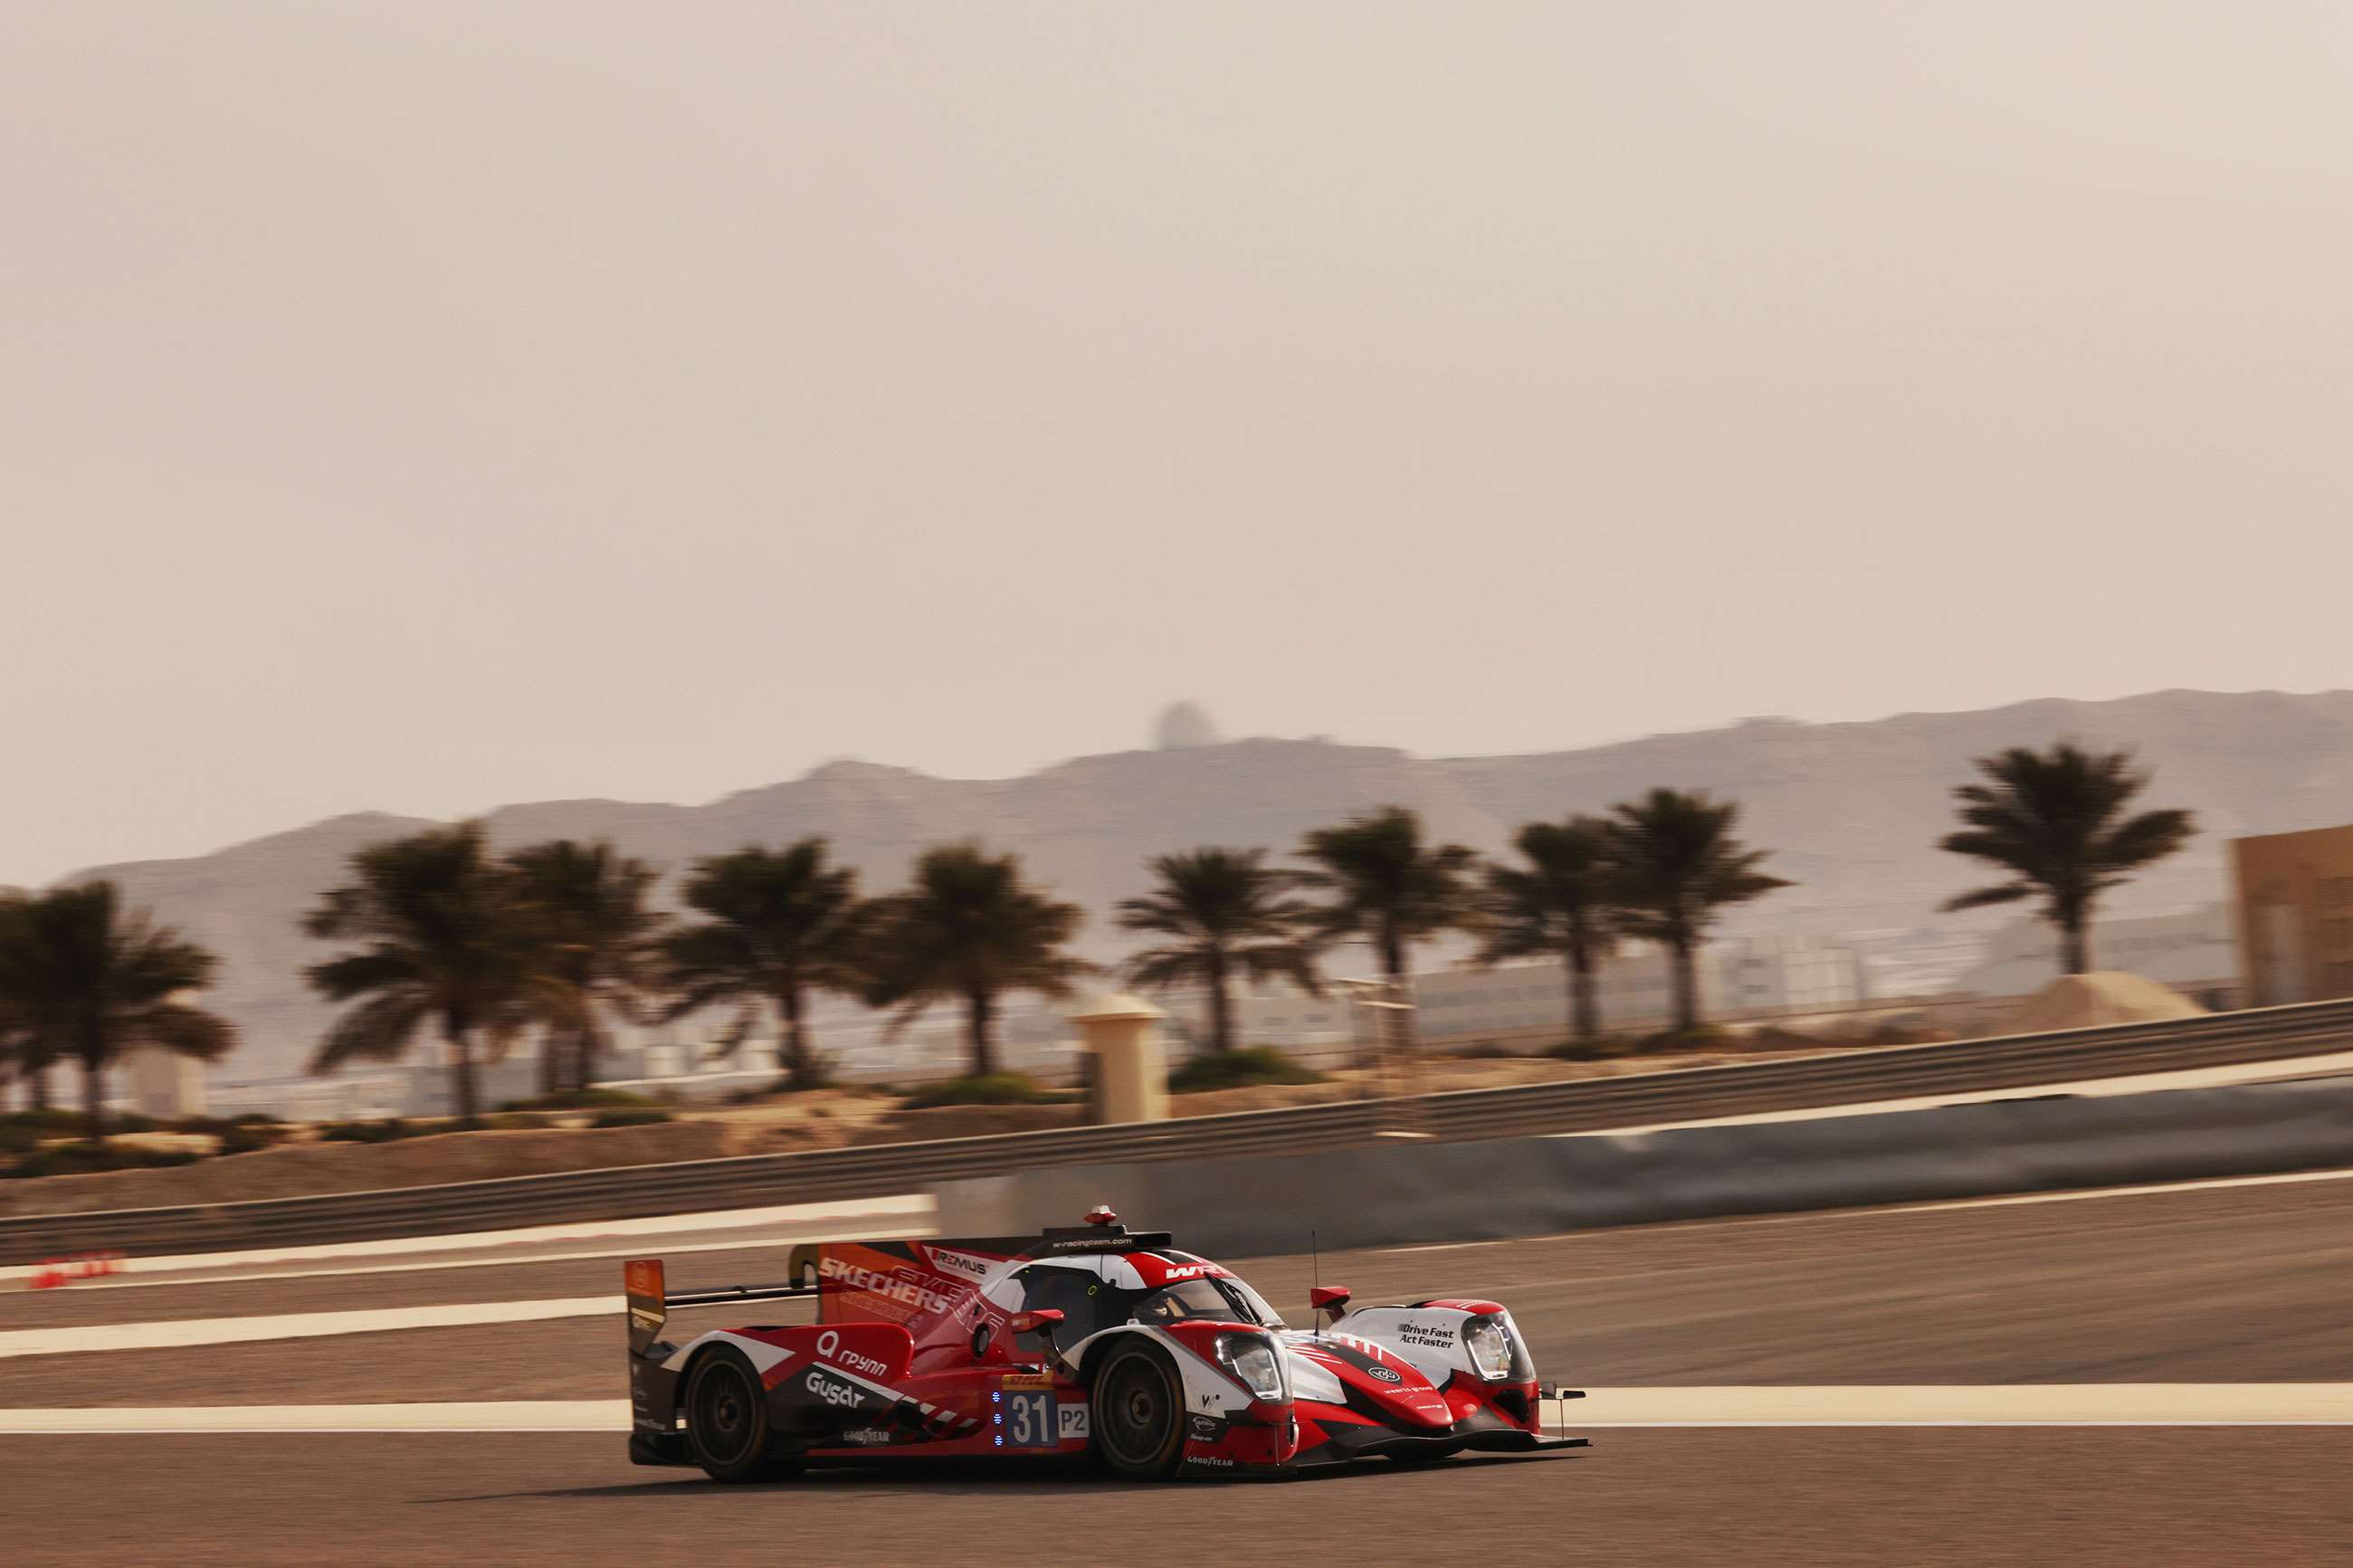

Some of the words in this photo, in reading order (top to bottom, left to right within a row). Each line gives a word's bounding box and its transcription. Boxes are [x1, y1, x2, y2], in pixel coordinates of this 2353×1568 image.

[939, 1251, 986, 1275] REMUS
[817, 1257, 949, 1315] SKECHERS
[1399, 1334, 1418, 1344] Act
[1417, 1335, 1454, 1349] Faster
[1402, 1323, 1429, 1335] Drive
[1429, 1327, 1455, 1339] Fast
[1012, 1394, 1050, 1444] 31
[1061, 1410, 1086, 1431] P2
[1186, 1455, 1234, 1467] GOODYEAR
